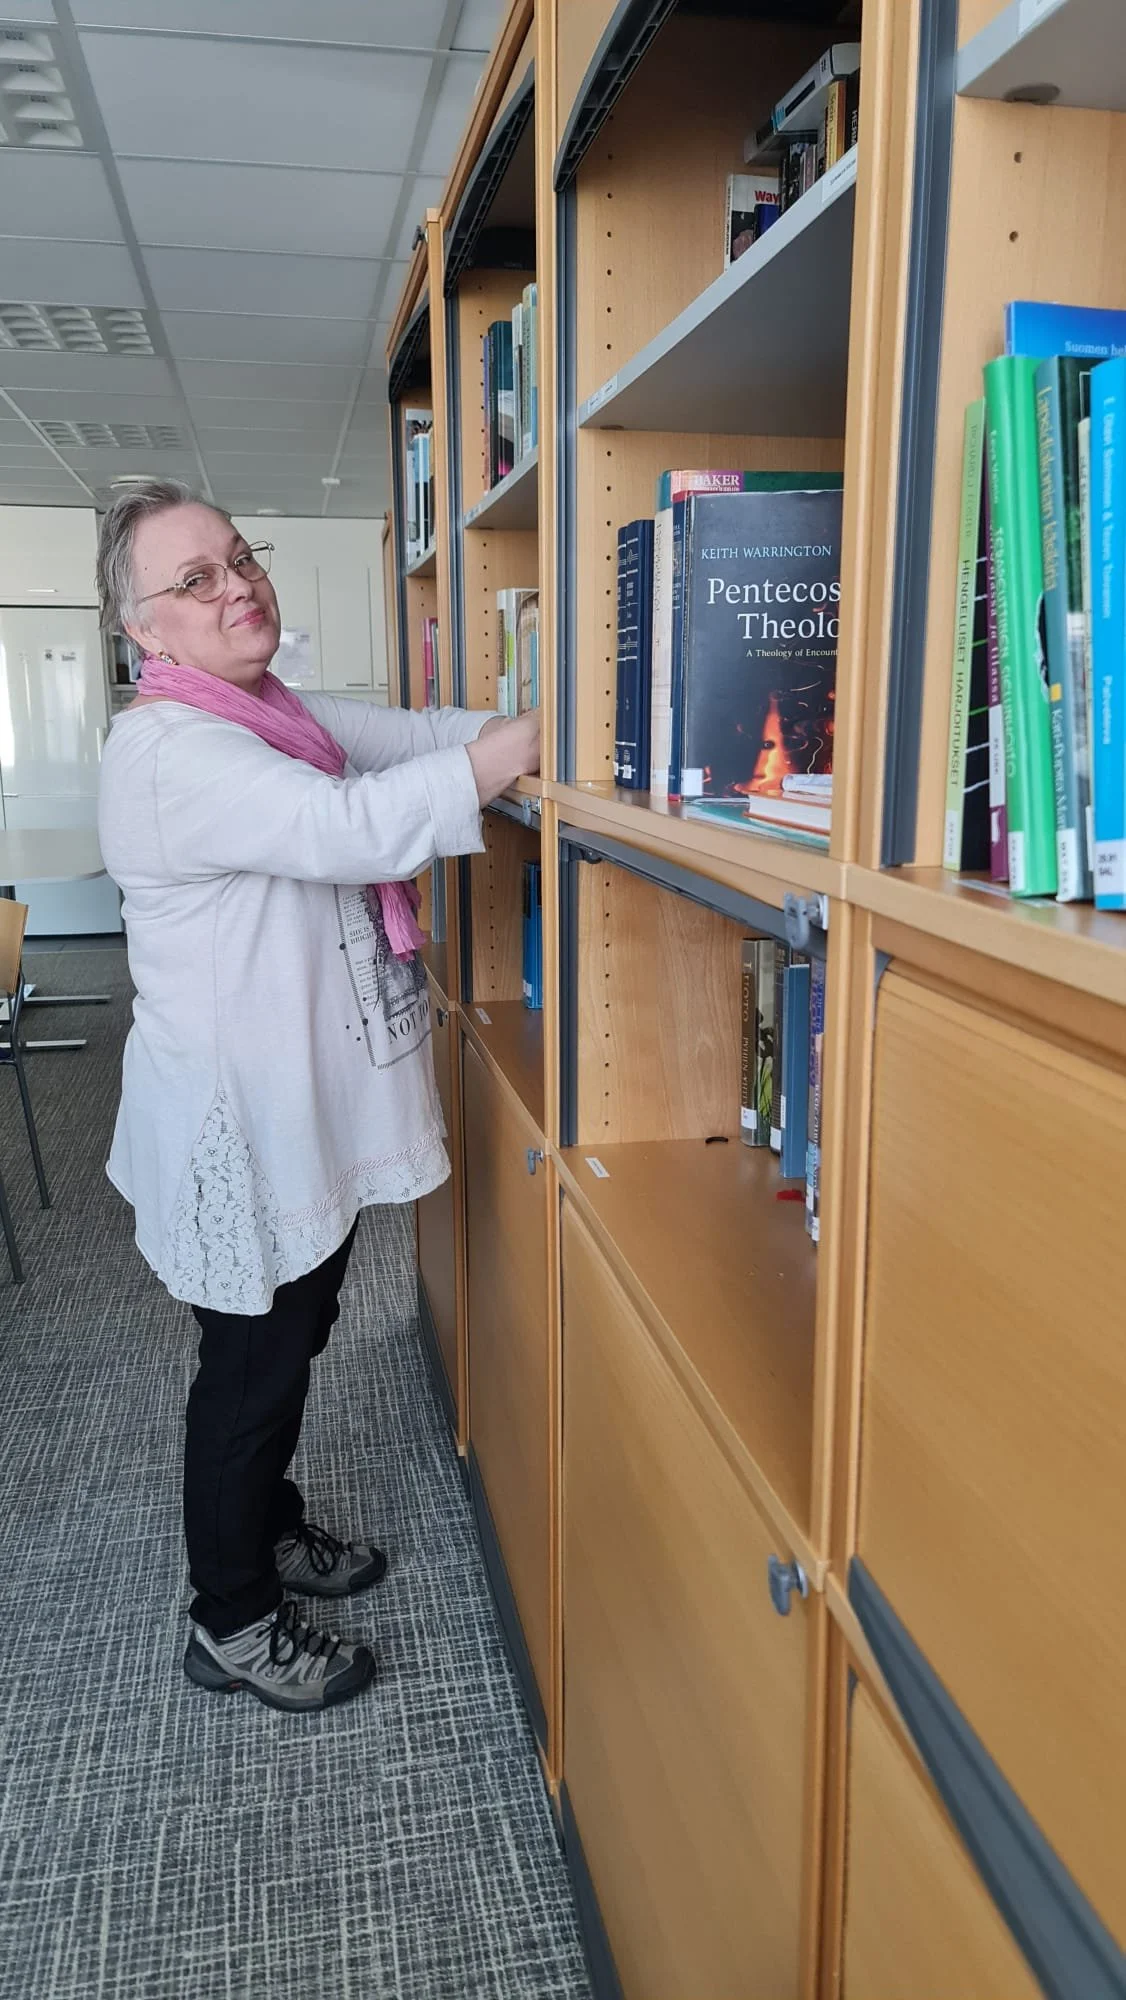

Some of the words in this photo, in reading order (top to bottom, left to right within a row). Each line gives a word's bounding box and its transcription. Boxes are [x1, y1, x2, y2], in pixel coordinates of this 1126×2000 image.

[1065, 341, 1108, 355] Suomen
[695, 474, 740, 486] BAKER
[701, 548, 738, 560] KEITH
[743, 545, 832, 558] WARRINGTON
[707, 578, 841, 604] Pentecos
[957, 560, 971, 664] HENGELLISET
[746, 649, 753, 657] A
[755, 649, 792, 660] Theology
[795, 649, 804, 657] of
[806, 648, 838, 657] Encount
[990, 646, 1000, 704] tilassa
[951, 672, 965, 788] HARJOITUKSET
[388, 1010, 417, 1045] NOT
